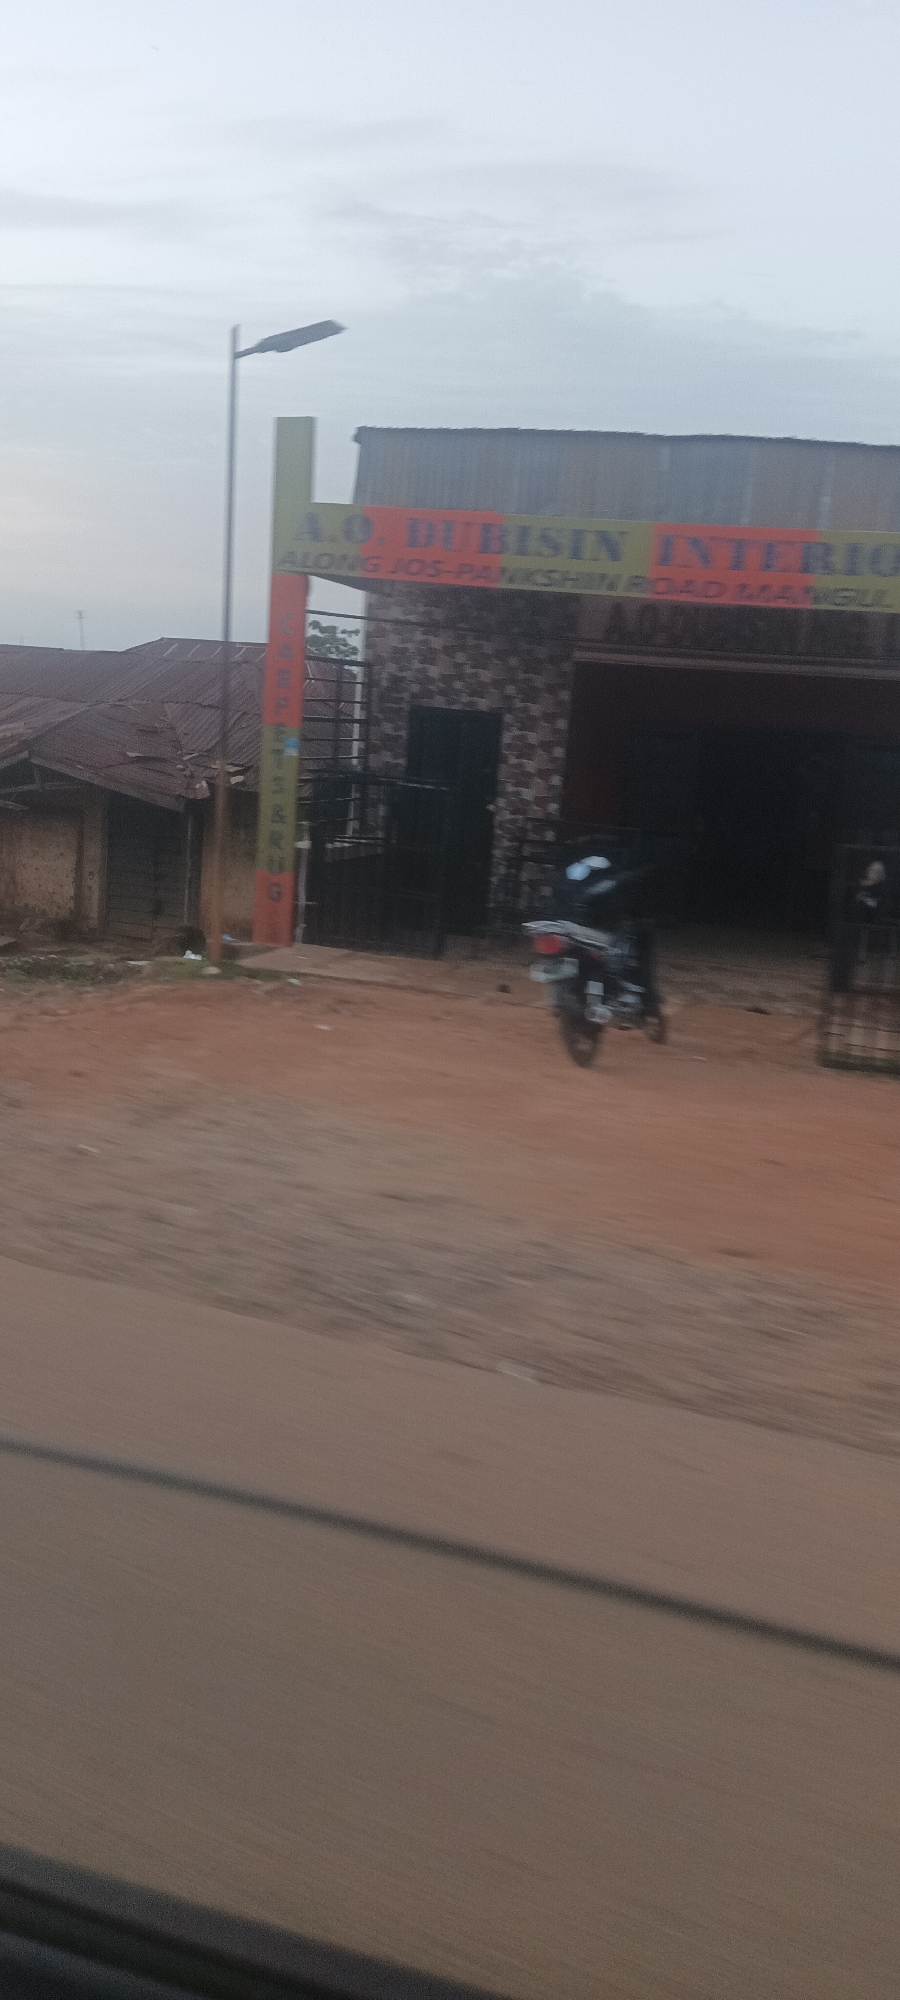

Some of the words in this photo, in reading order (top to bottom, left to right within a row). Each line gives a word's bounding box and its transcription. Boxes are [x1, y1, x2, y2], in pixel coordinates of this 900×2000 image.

[404, 516, 628, 563] DUBISIN
[276, 549, 383, 575] ALONG
[386, 556, 623, 593] JOS-PANKSHIN
[622, 574, 728, 599] ROAD
